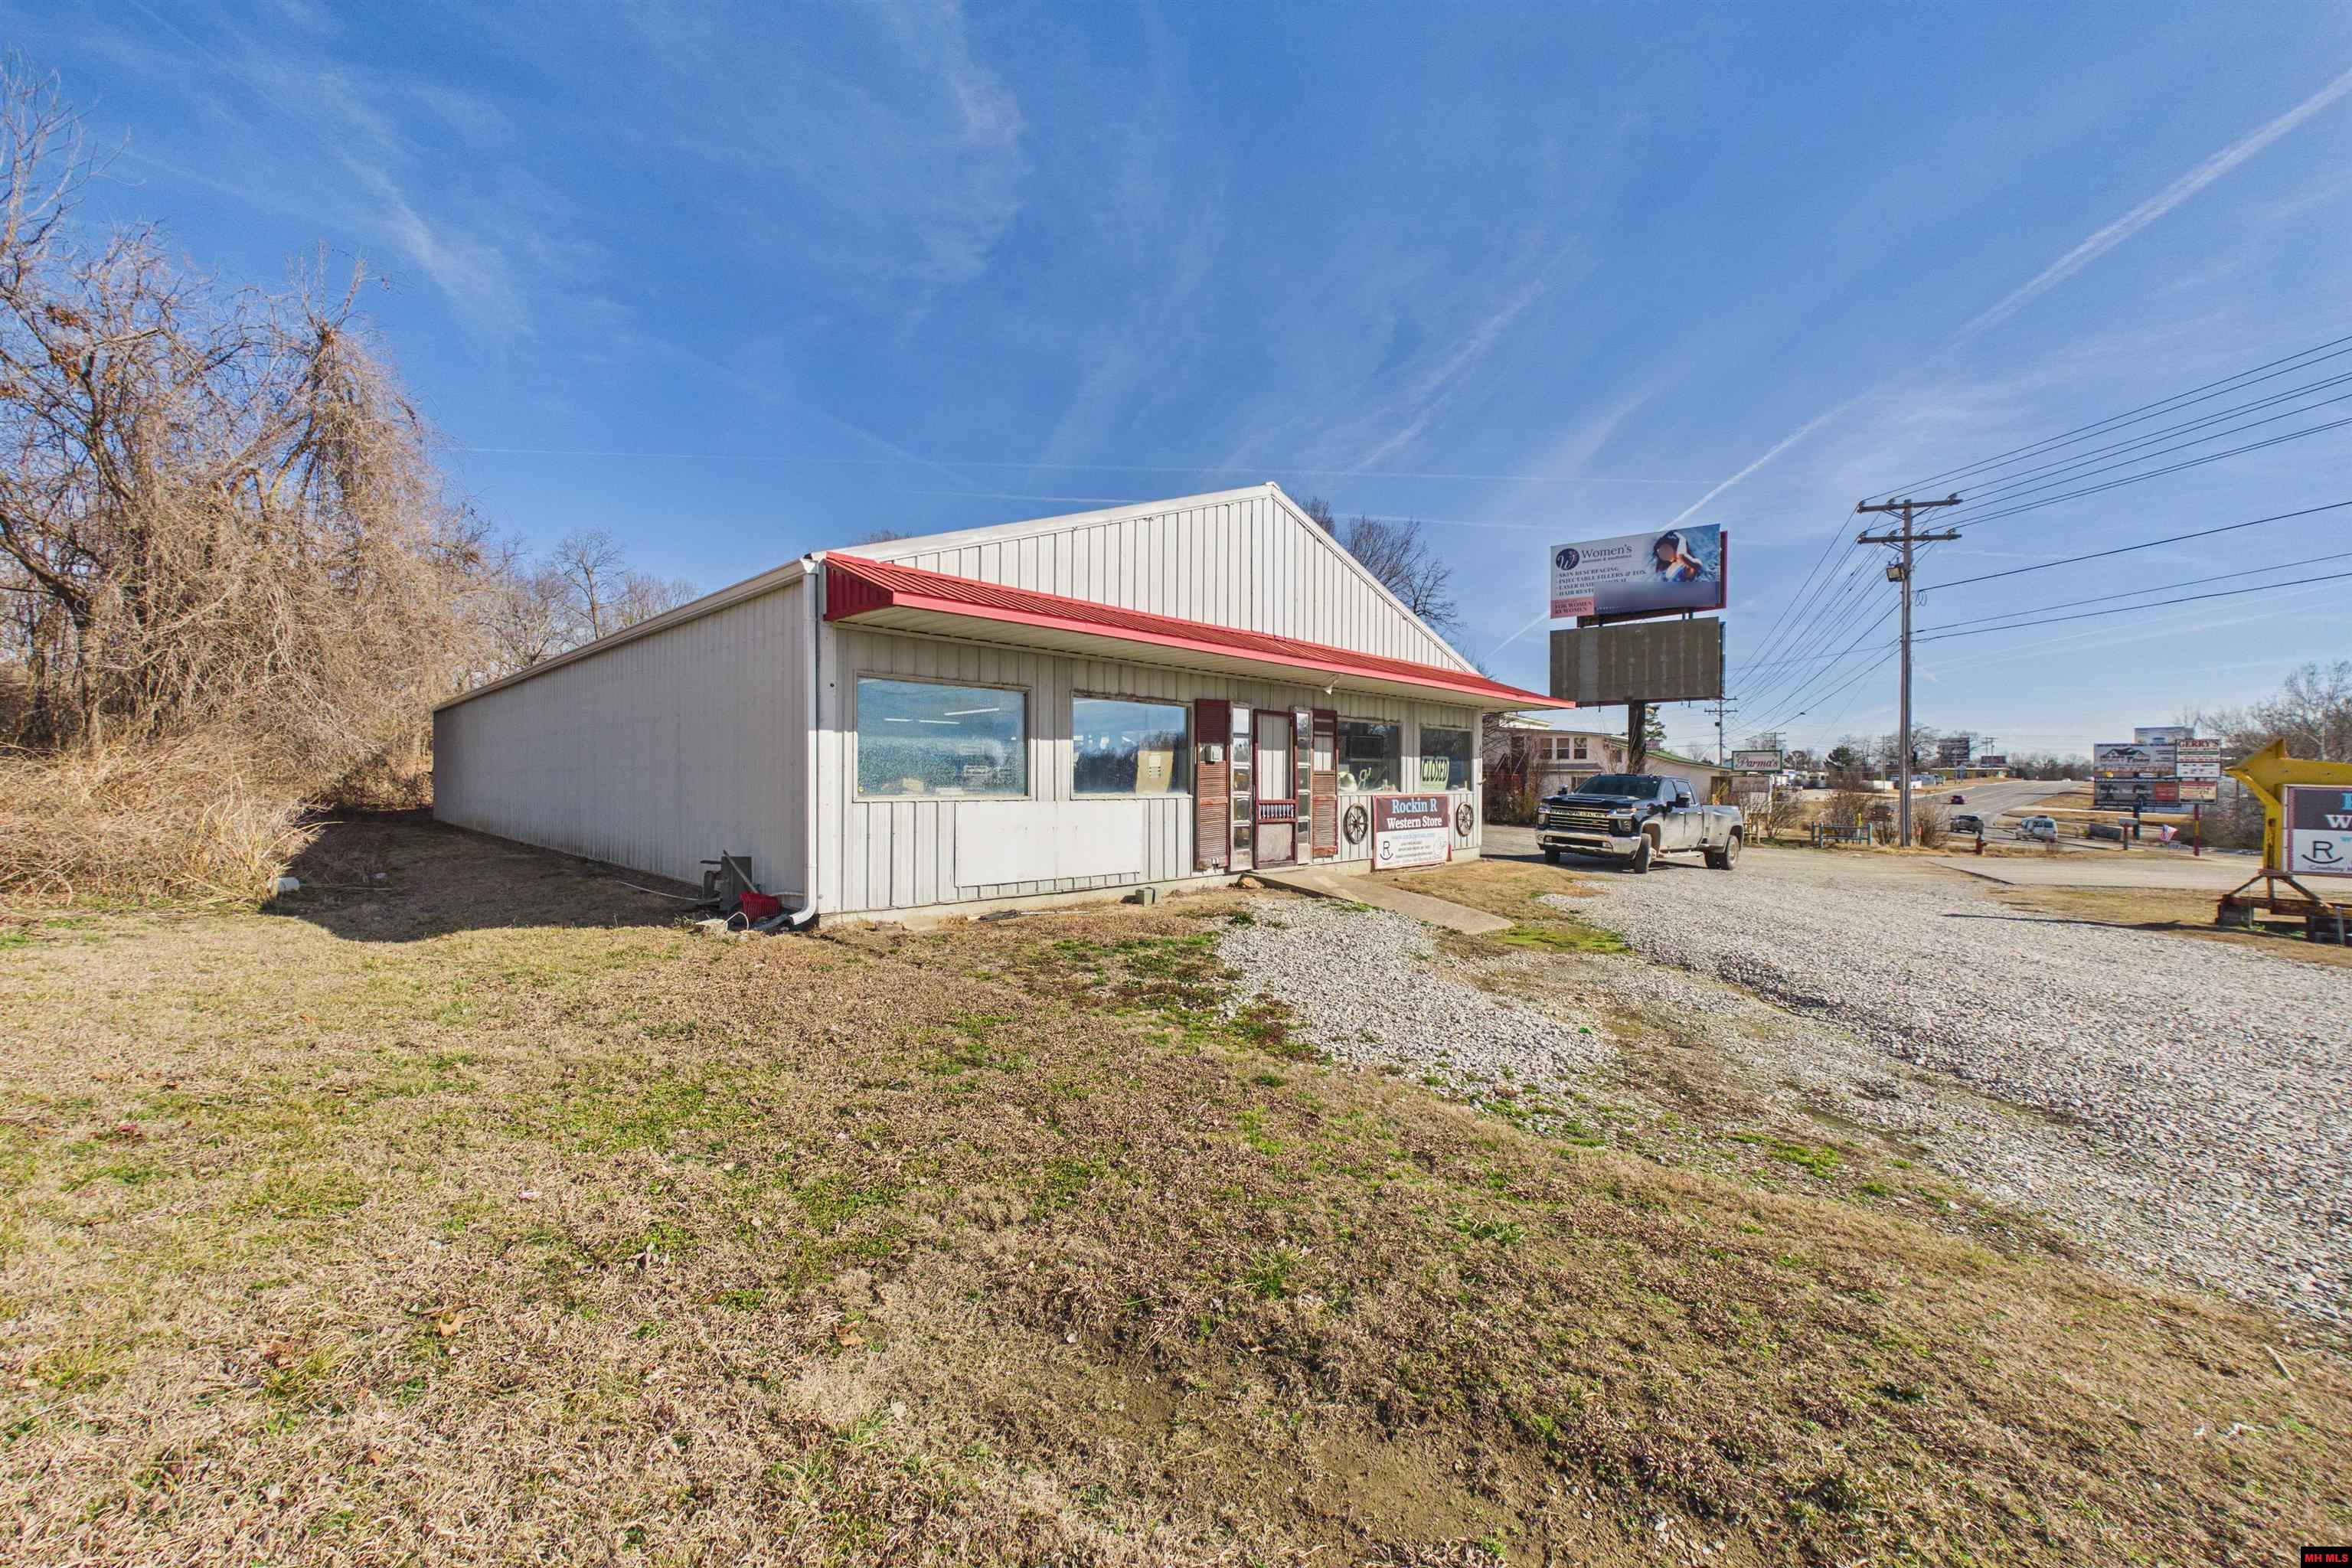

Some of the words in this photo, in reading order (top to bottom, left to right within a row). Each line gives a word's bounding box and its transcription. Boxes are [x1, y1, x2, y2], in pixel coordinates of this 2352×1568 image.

[1581, 544, 1632, 558] Women's
[2180, 740, 2218, 748] GERRY'S
[1736, 756, 1779, 769] Parma's
[1423, 759, 1449, 782] CLOSED
[1392, 797, 1428, 814] Rockin
[1429, 798, 1438, 812] R
[1387, 816, 1421, 829] Western
[1423, 815, 1442, 827] Store
